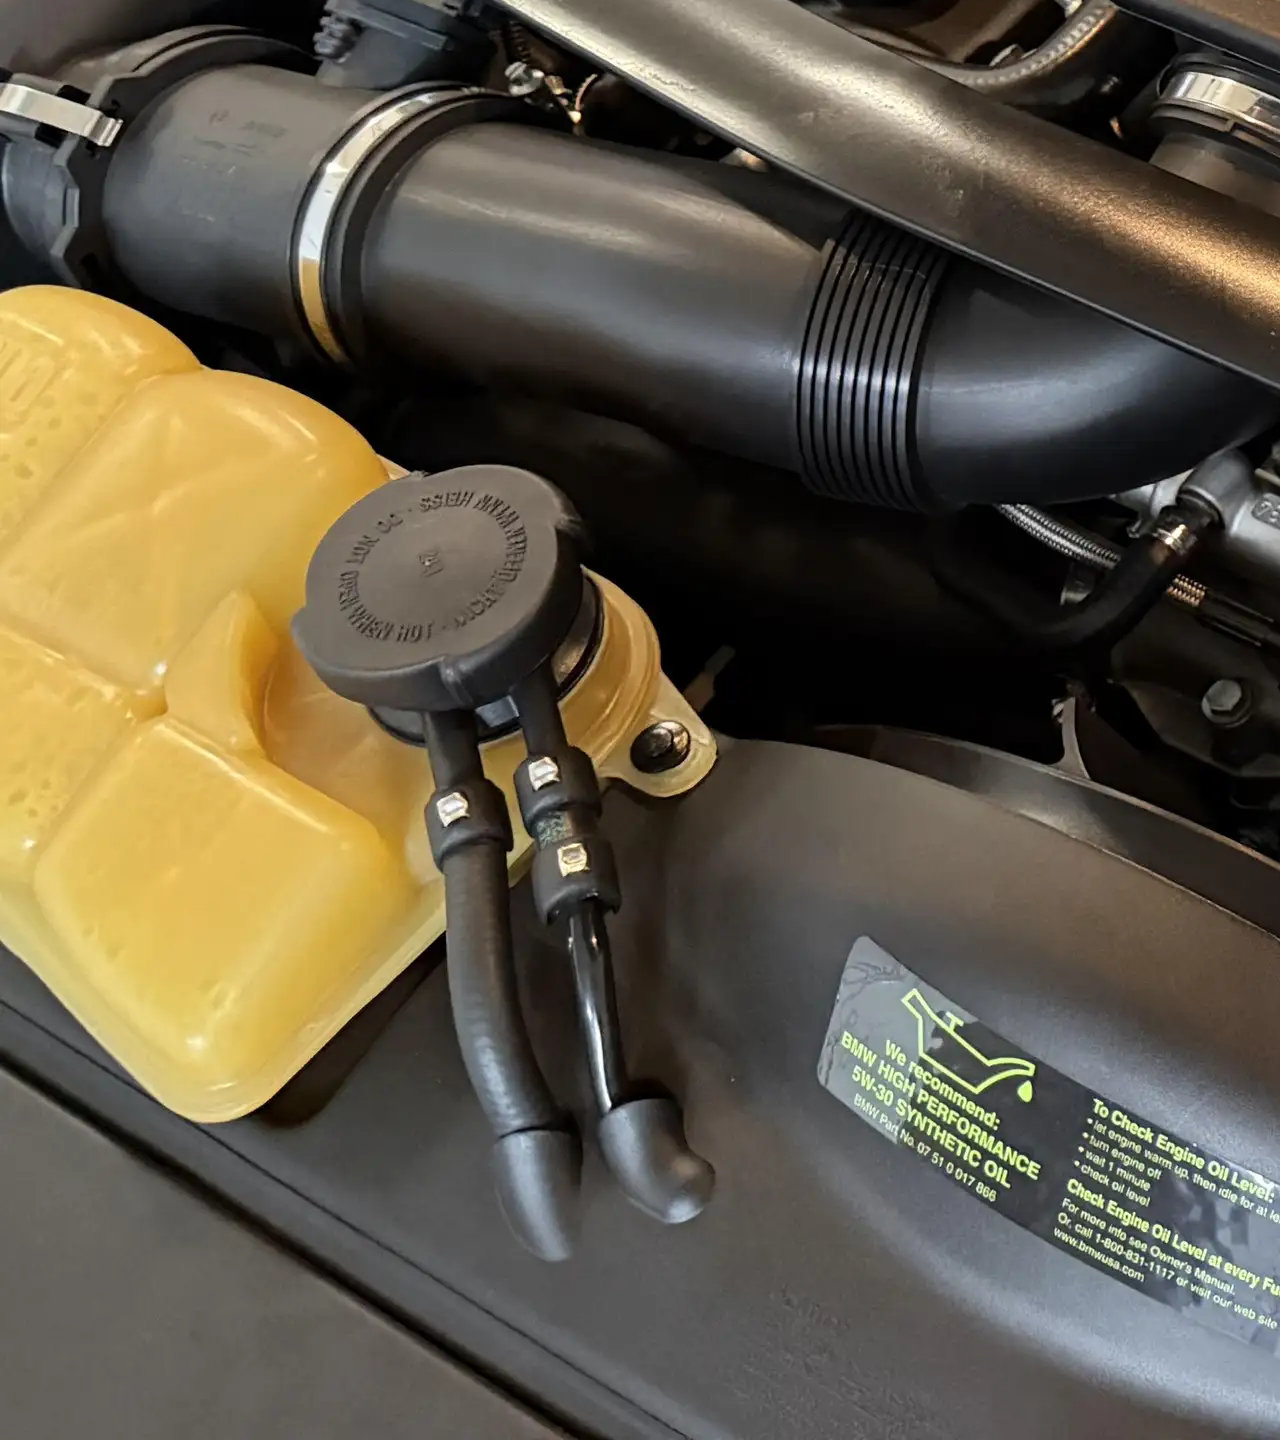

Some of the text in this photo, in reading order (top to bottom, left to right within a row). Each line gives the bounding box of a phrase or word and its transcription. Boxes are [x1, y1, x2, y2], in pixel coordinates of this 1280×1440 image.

[841, 1031, 1042, 1180] BMW HIGH PERFORMANCE
[852, 1065, 1011, 1188] 5W-30 SYNTHETIC OIL
[885, 1040, 1000, 1130] We recommend:
[854, 1093, 877, 1120] BMW
[879, 1115, 898, 1136] Part
[900, 1130, 915, 1149] No.
[917, 1142, 932, 1157] 07
[932, 1153, 944, 1168] 51
[946, 1162, 954, 1174] 0
[955, 1167, 974, 1186] 017
[1081, 1163, 1150, 1208] check oil level
[1085, 1150, 1106, 1168] wait
[1117, 1167, 1150, 1192] minute
[1088, 1135, 1162, 1180] turn engine off
[1092, 1098, 1275, 1203] To Check Engine Oil Level:
[1094, 1120, 1107, 1134] let
[1108, 1130, 1142, 1154] engine
[1144, 1149, 1172, 1170] warm
[1193, 1173, 1217, 1192] then
[1219, 1187, 1237, 1203] idle
[1240, 1196, 1255, 1210] for
[1256, 1206, 1267, 1217] at
[1053, 1227, 1145, 1282] www.bmwusa.com
[1058, 1212, 1072, 1229] Or,
[1075, 1222, 1093, 1239] call
[1095, 1233, 1175, 1281] 1-800-831-1117
[1176, 1276, 1188, 1288] or
[1190, 1283, 1211, 1300] visit
[1213, 1294, 1232, 1308] our
[1234, 1303, 1256, 1321] web
[1258, 1314, 1278, 1329] site
[1062, 1198, 1236, 1296] For more info see Owner's Manual.
[1067, 1178, 1105, 1210] Check
[1106, 1200, 1150, 1233] Engine
[1152, 1224, 1171, 1243] Oil
[1172, 1234, 1208, 1262] Level
[1208, 1255, 1223, 1268] at
[1224, 1261, 1260, 1289] every
